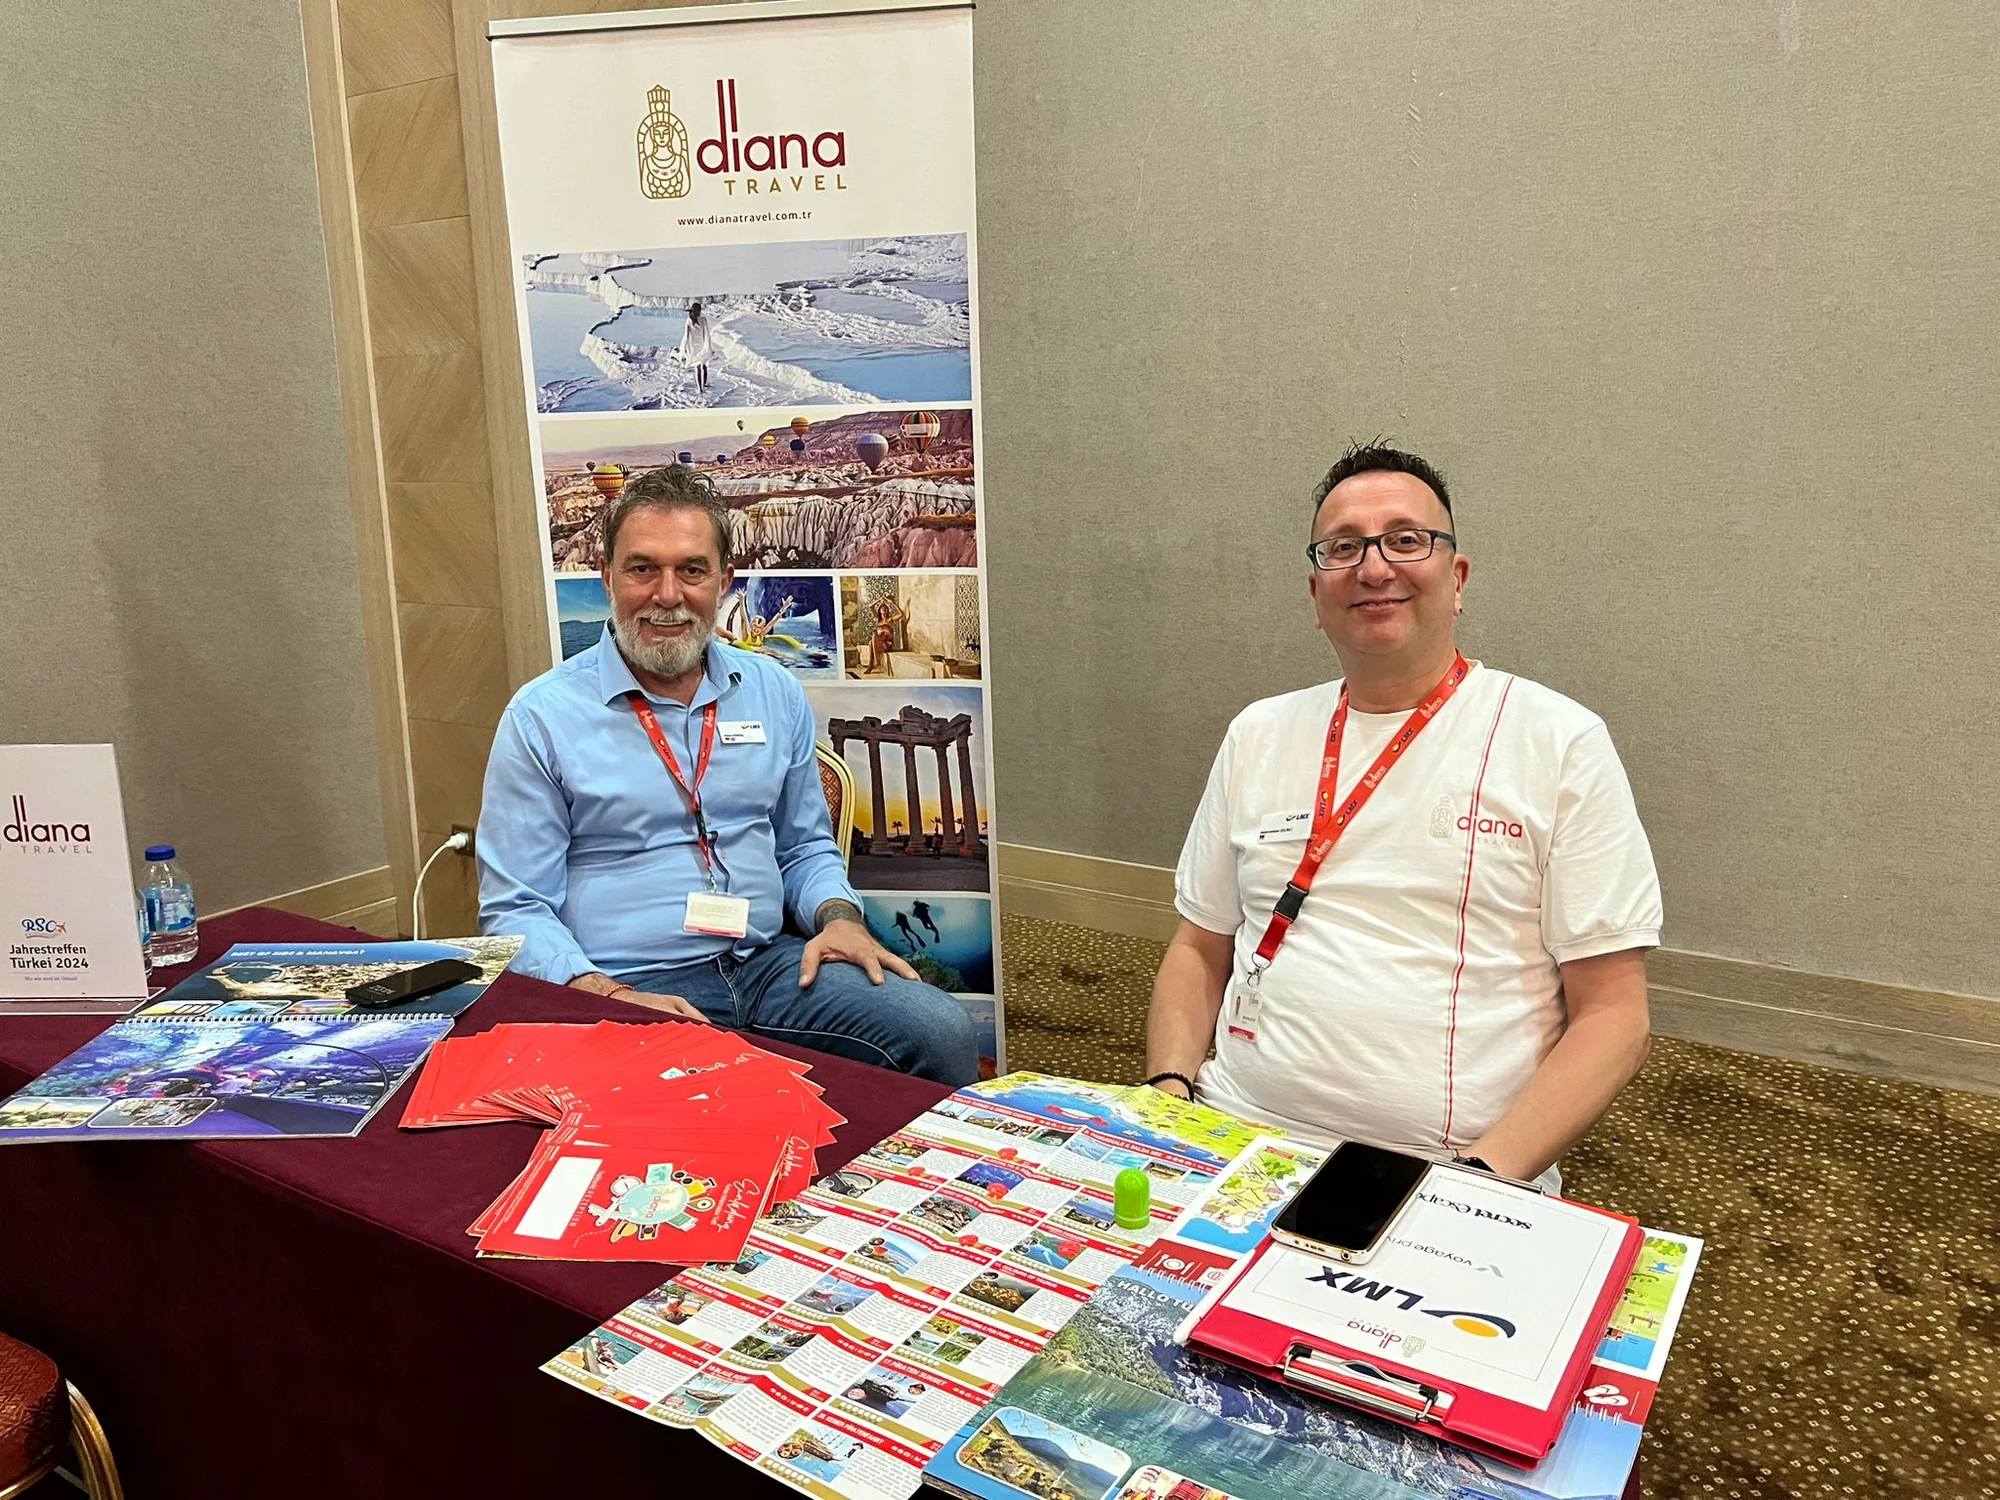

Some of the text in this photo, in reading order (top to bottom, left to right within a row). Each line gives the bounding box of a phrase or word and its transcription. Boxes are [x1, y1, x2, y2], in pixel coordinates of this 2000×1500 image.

[696, 78, 846, 174] diana
[724, 174, 847, 196] TRAVEL
[677, 210, 812, 227] www.dianatravel.com.tr
[3, 795, 91, 843] diana
[1457, 798, 1522, 838] diana
[20, 845, 92, 854] TRAVEL
[9, 943, 86, 954] Jahrestreffen
[9, 957, 89, 968] Türkei 2024
[1474, 1207, 1532, 1230] secret
[1414, 1243, 1472, 1266] voyage
[1117, 1280, 1170, 1302] HALLO
[1305, 1265, 1424, 1310] LMX
[632, 1330, 655, 1344] CRUISE
[1347, 1320, 1402, 1349] diana
[918, 1371, 948, 1386] SUNSET
